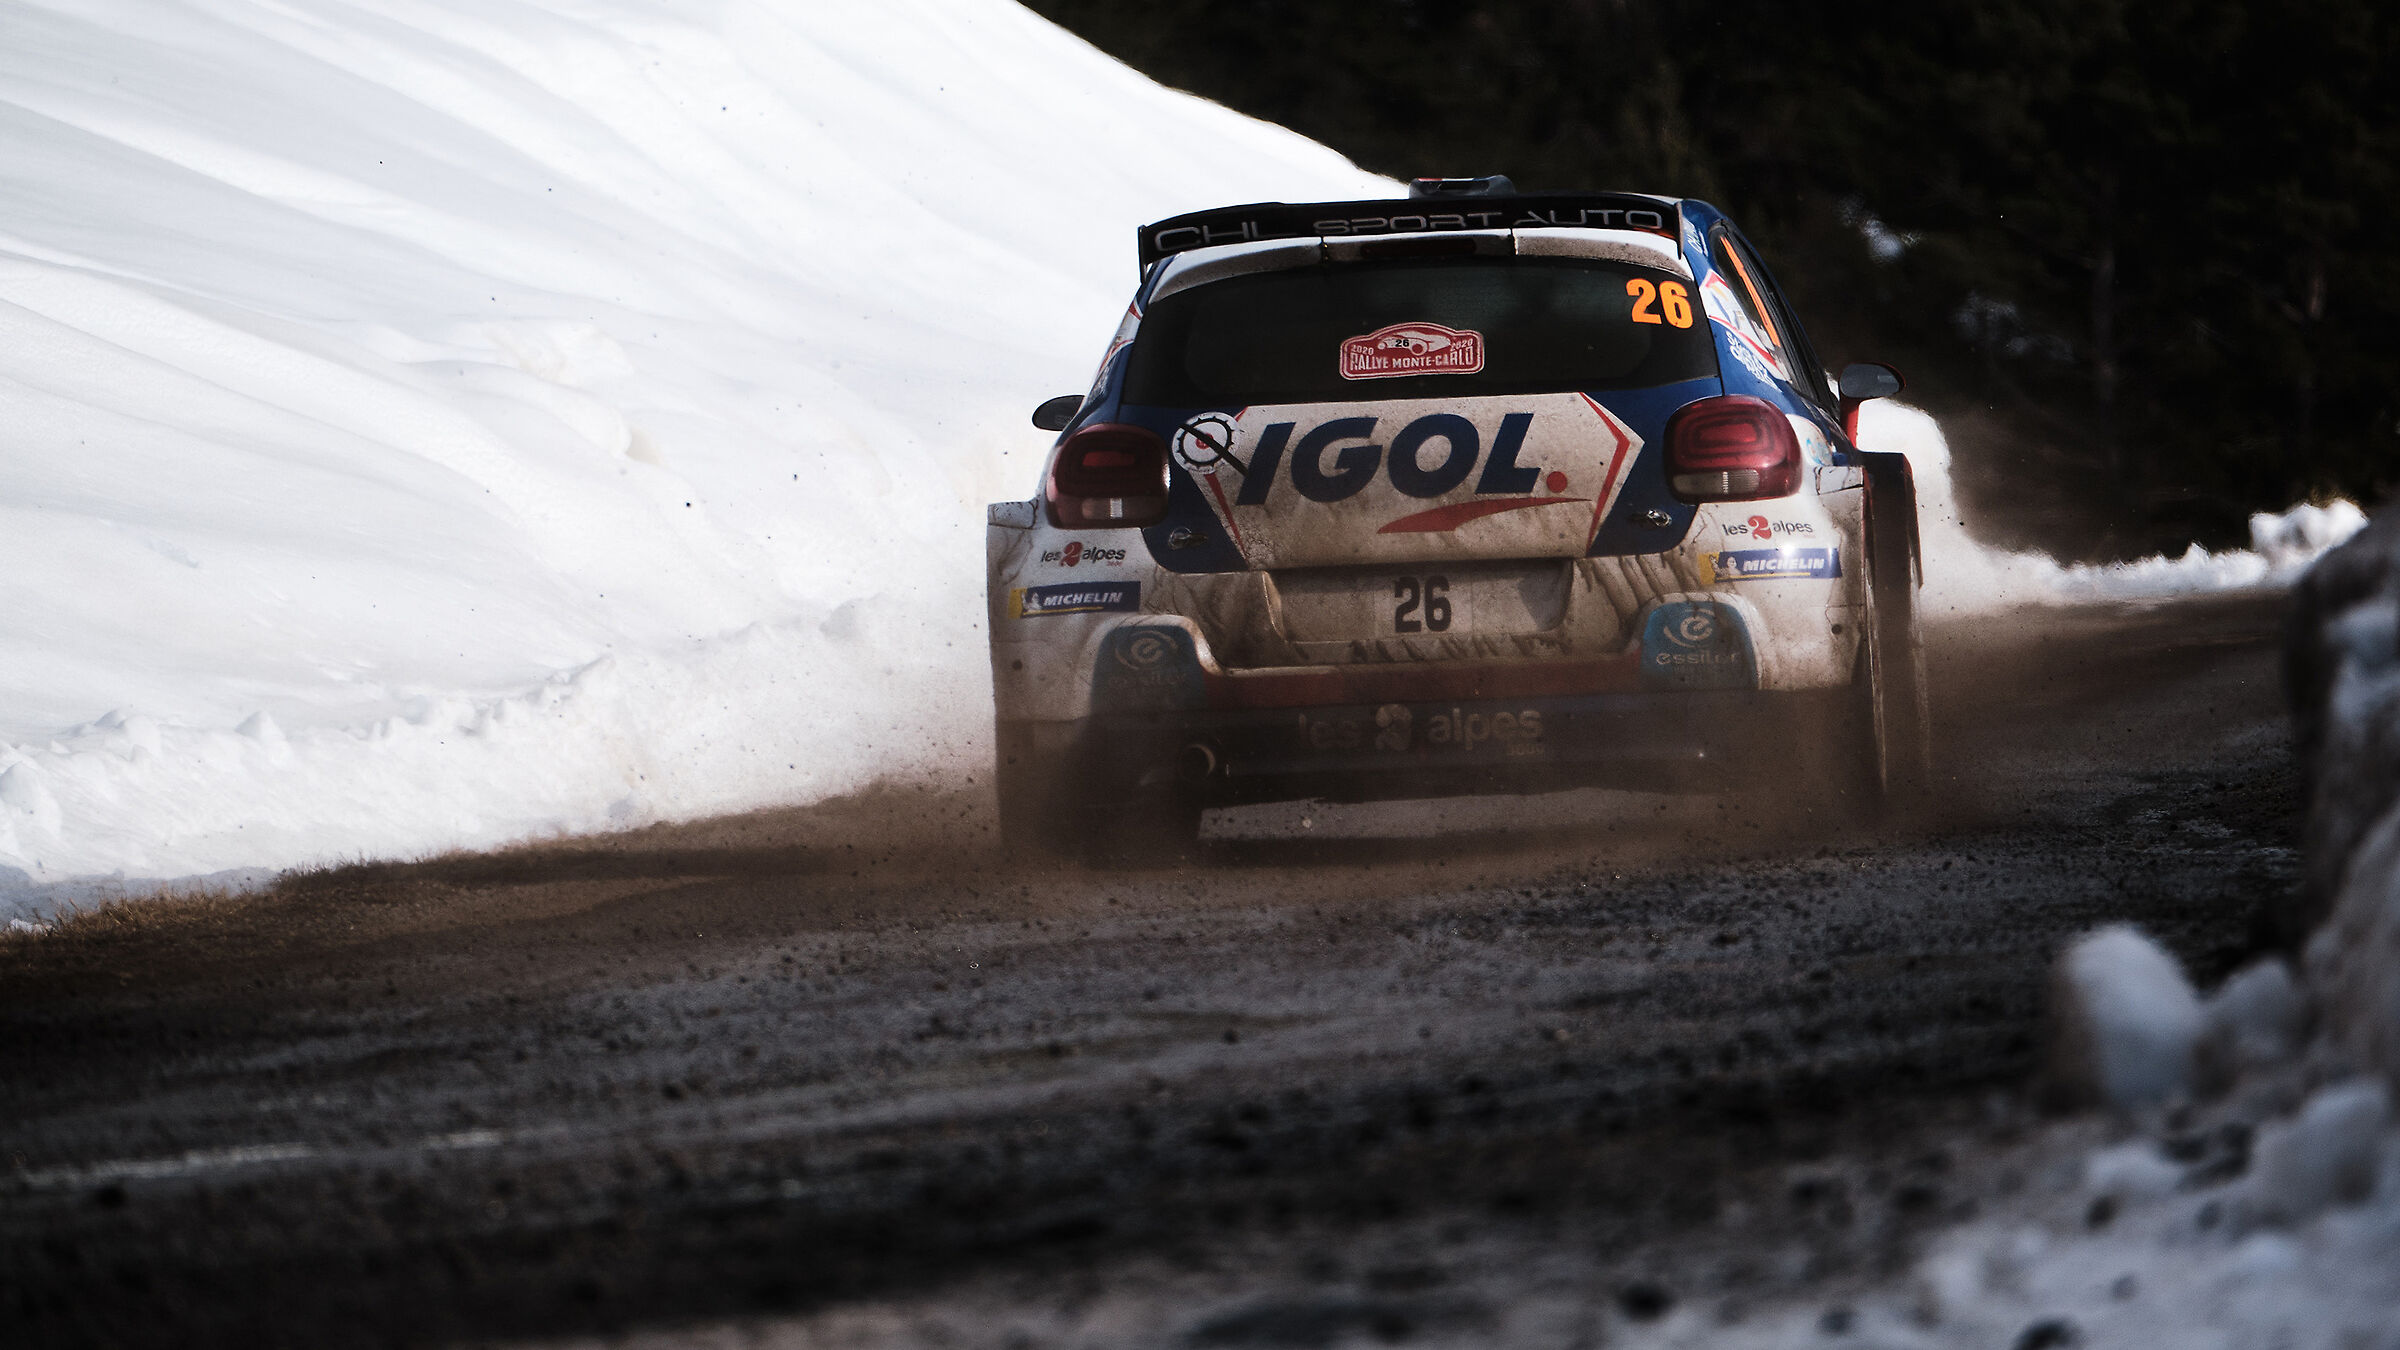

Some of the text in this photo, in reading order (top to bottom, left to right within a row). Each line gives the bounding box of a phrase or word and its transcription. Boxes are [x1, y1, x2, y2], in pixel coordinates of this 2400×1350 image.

[1155, 208, 1663, 252] CHL SPORT AUTO
[1626, 278, 1693, 328] 26
[1351, 344, 1374, 356] 2020
[1395, 338, 1410, 348] 26
[1450, 338, 1474, 352] 2020
[1350, 346, 1474, 371] RALLYE MONTE-CARLO
[1743, 558, 1825, 572] MICHELIN
[1043, 592, 1123, 607] MICHELIN
[1394, 575, 1452, 634] 26
[1426, 707, 1544, 750] alpes
